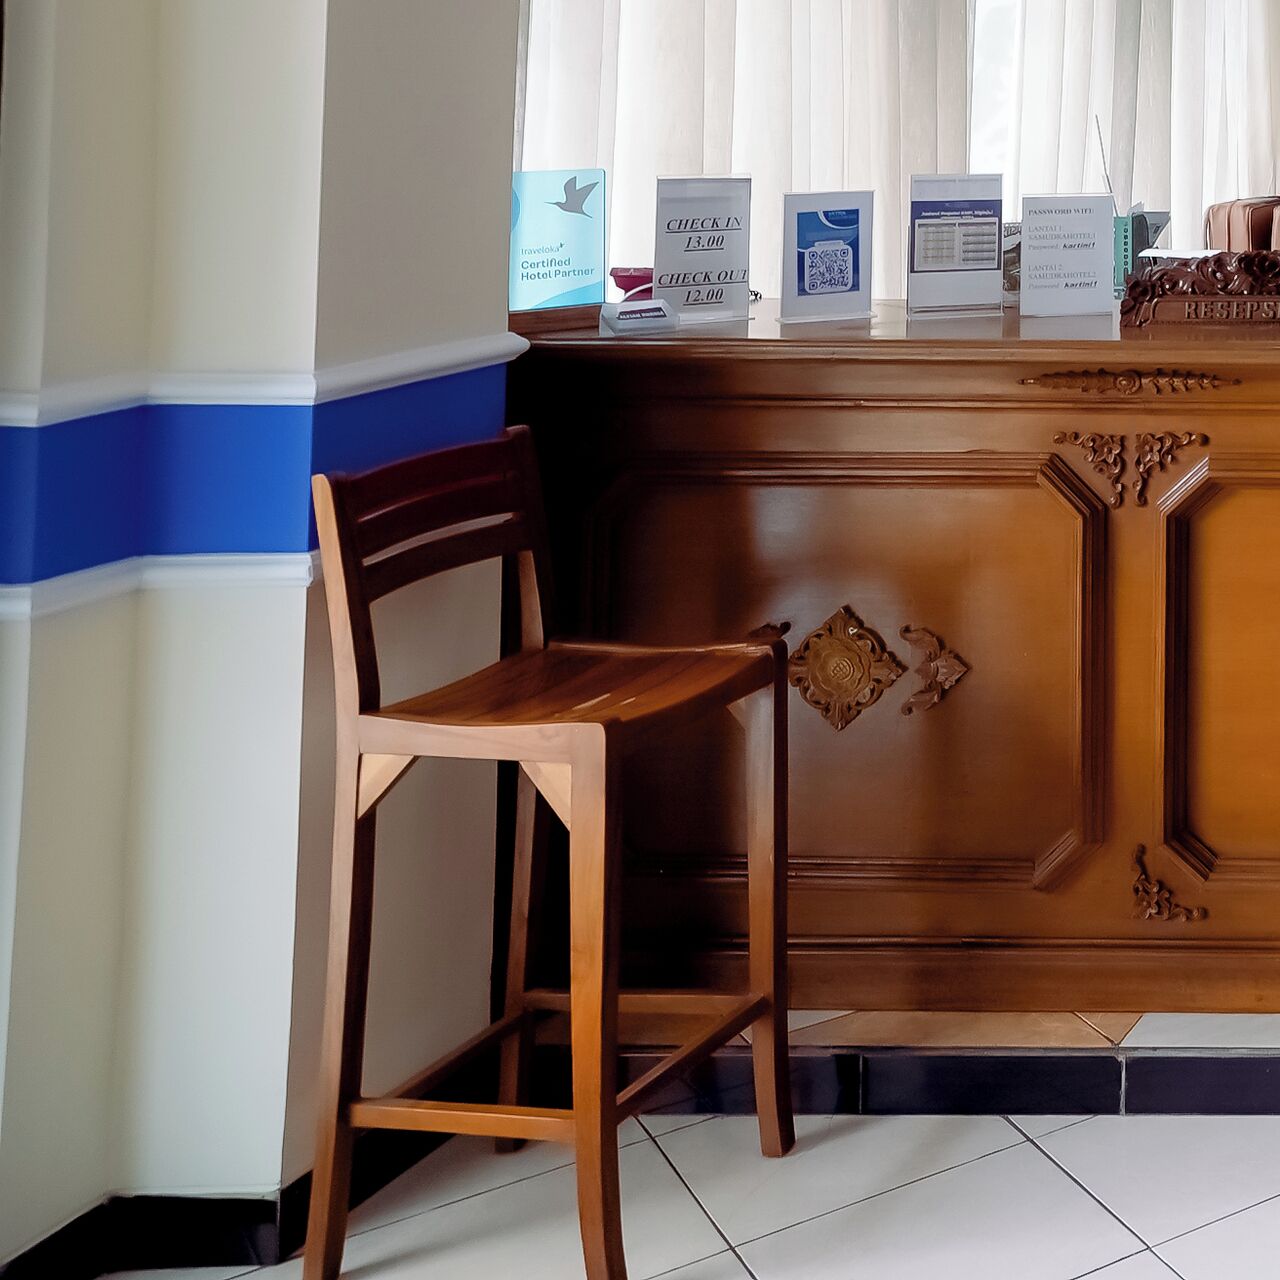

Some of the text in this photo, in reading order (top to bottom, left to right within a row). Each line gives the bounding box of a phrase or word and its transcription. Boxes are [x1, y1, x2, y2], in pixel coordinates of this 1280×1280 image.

[1028, 208, 1072, 217] PASSWORD
[666, 216, 744, 231] CHECK IN
[685, 235, 725, 250] 13.00
[521, 258, 571, 270] Certified
[521, 268, 595, 282] Hotel Partner
[658, 269, 748, 286] CHECK OUT
[684, 288, 724, 304] 12.00
